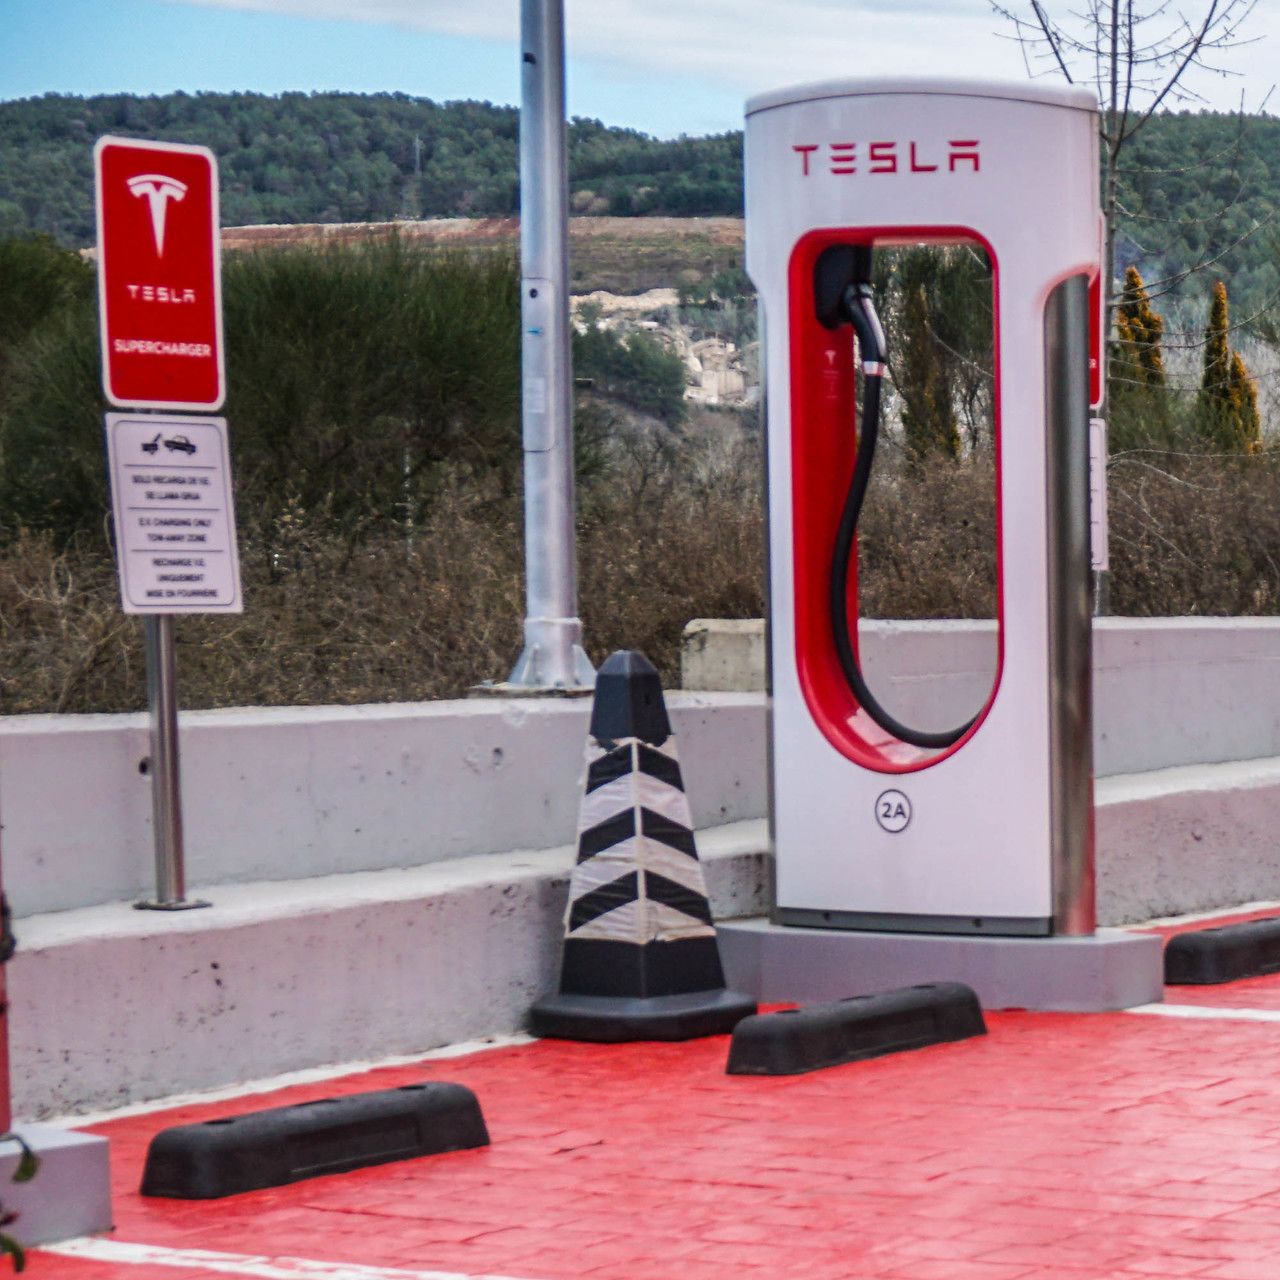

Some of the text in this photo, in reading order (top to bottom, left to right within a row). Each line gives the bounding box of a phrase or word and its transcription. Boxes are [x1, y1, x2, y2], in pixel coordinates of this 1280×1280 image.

[792, 140, 980, 176] TESLA
[127, 284, 196, 303] TESLA
[114, 339, 212, 357] SUPERCHARGER
[882, 802, 907, 819] 2A
